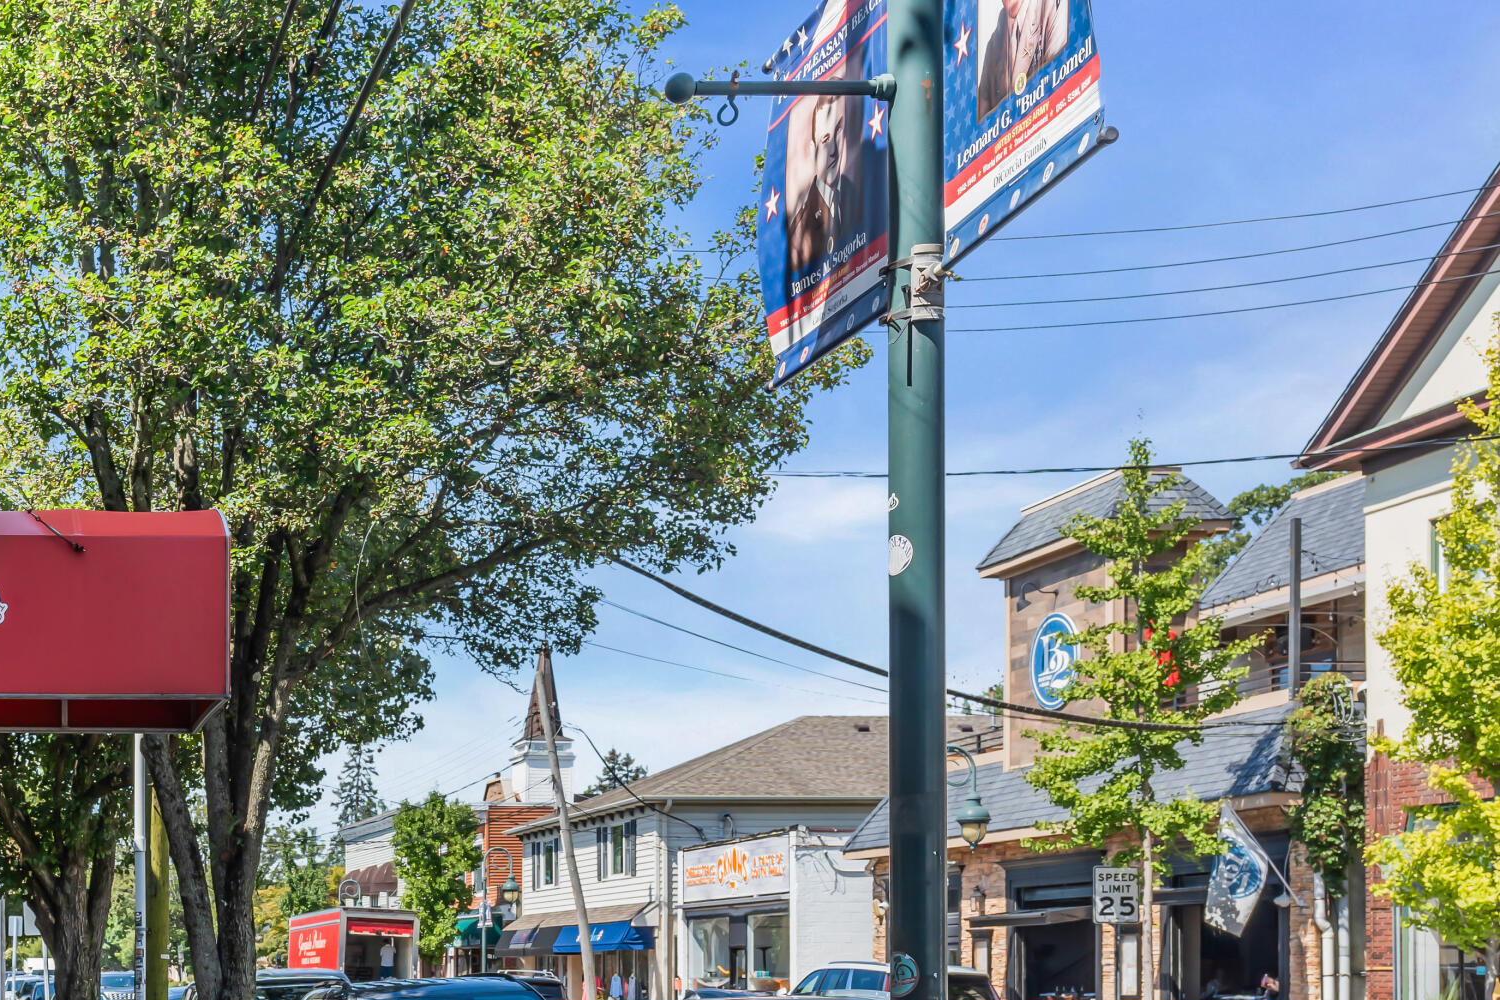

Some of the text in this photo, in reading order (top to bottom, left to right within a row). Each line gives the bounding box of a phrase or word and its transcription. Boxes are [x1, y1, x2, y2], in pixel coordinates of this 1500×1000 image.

[803, 24, 848, 79] PLEASANT
[811, 48, 842, 80] HONORS
[956, 34, 1093, 171] Leonard G. "Bud" Lomell
[994, 101, 1049, 154] UNITED STATES ARMY
[1024, 137, 1048, 163] Family
[791, 270, 821, 297] James
[832, 232, 867, 267] Sogorka
[1098, 873, 1136, 882] SPEED
[1102, 884, 1131, 894] LIMIT
[1099, 896, 1135, 916] 25
